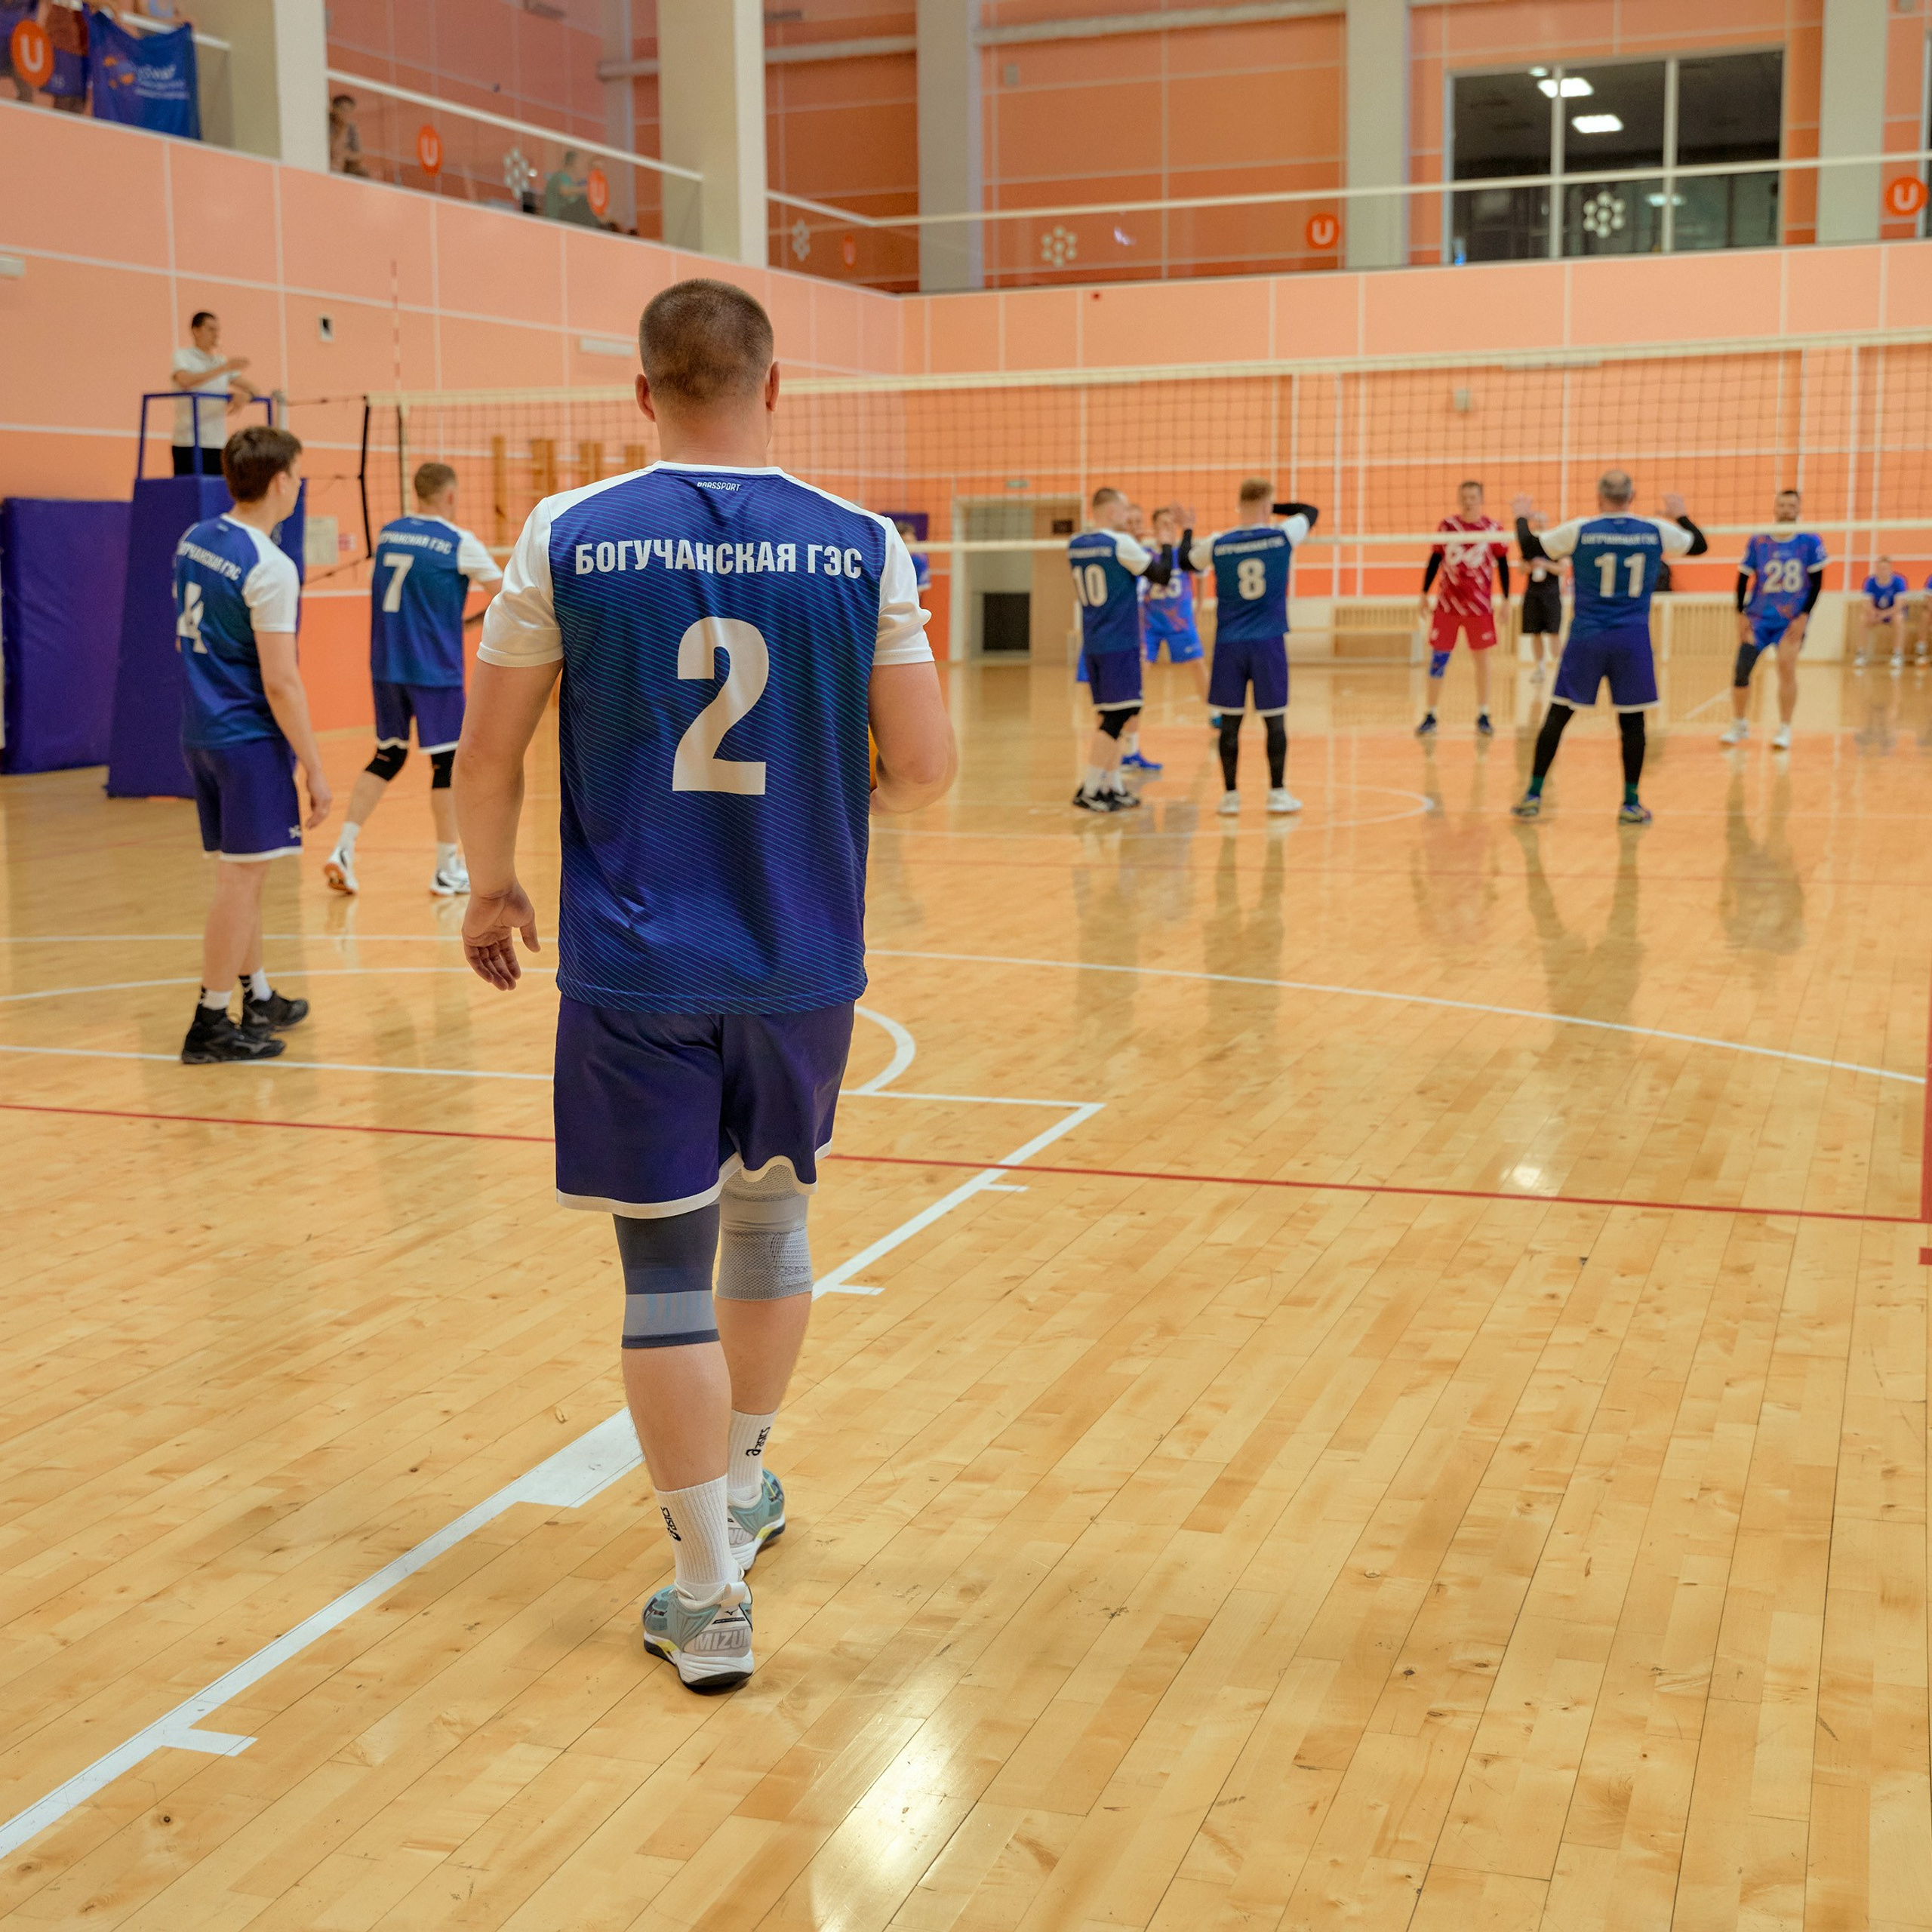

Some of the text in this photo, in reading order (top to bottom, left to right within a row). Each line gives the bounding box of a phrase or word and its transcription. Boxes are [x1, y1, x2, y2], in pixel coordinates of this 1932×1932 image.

[20, 33, 44, 72] U
[420, 134, 438, 168] U
[1894, 183, 1918, 211] U
[1312, 220, 1334, 245] U
[575, 539, 863, 580] БОГУЧАНСКАЯ ГЭС
[1237, 558, 1266, 600] 8
[1594, 552, 1646, 598] 11
[1763, 558, 1803, 593] 28
[383, 552, 414, 613] 7
[1073, 564, 1108, 607] 10
[672, 616, 769, 795] 2
